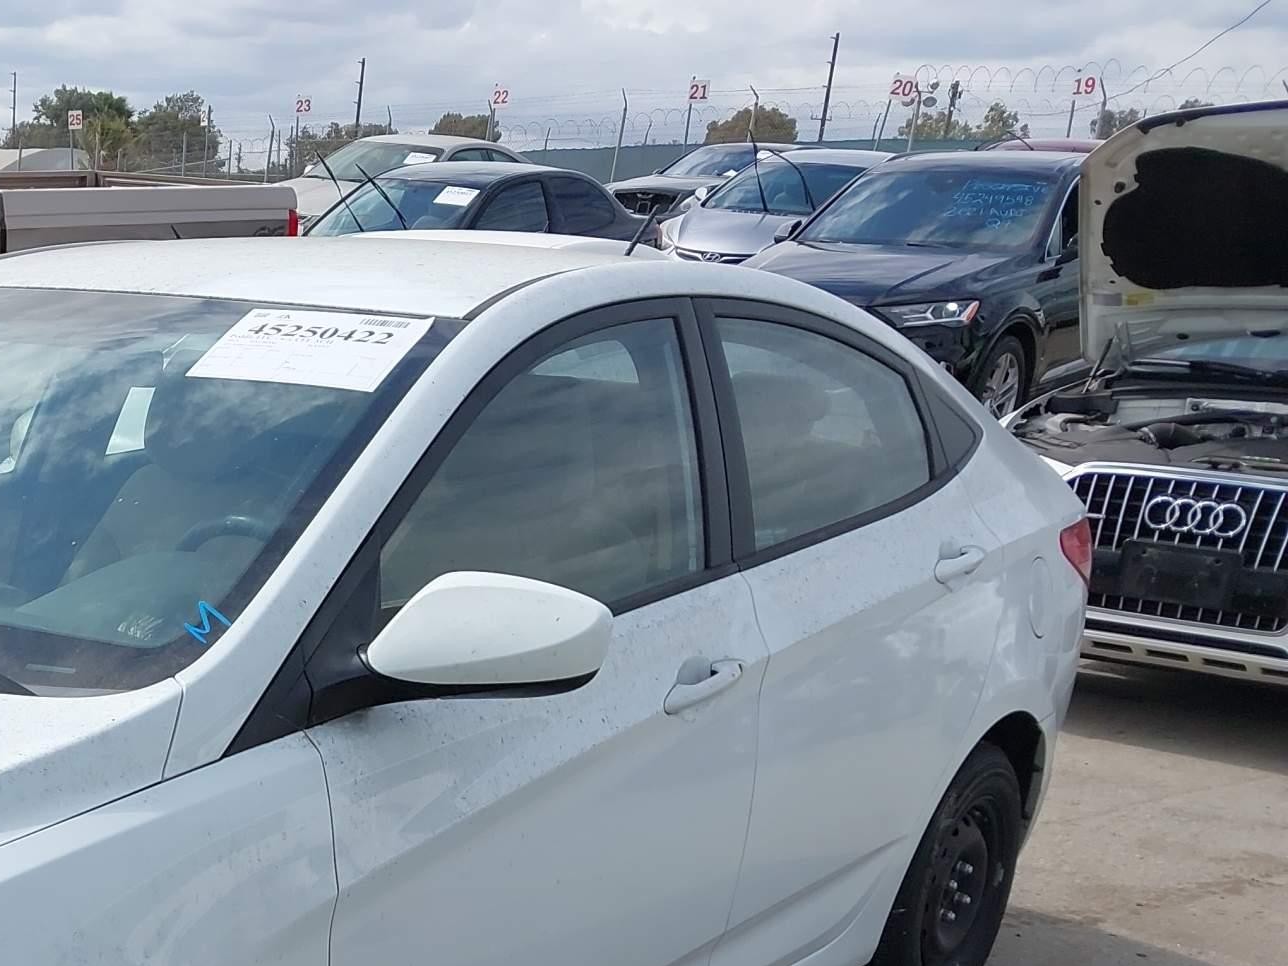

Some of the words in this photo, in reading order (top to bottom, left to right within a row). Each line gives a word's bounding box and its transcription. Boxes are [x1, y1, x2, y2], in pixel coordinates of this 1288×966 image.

[689, 84, 709, 100] 21
[890, 79, 913, 97] 20
[1073, 77, 1096, 95] 19
[493, 90, 509, 104] 22
[296, 99, 311, 113] 23
[69, 113, 82, 126] 25
[247, 322, 395, 345] 45250422
